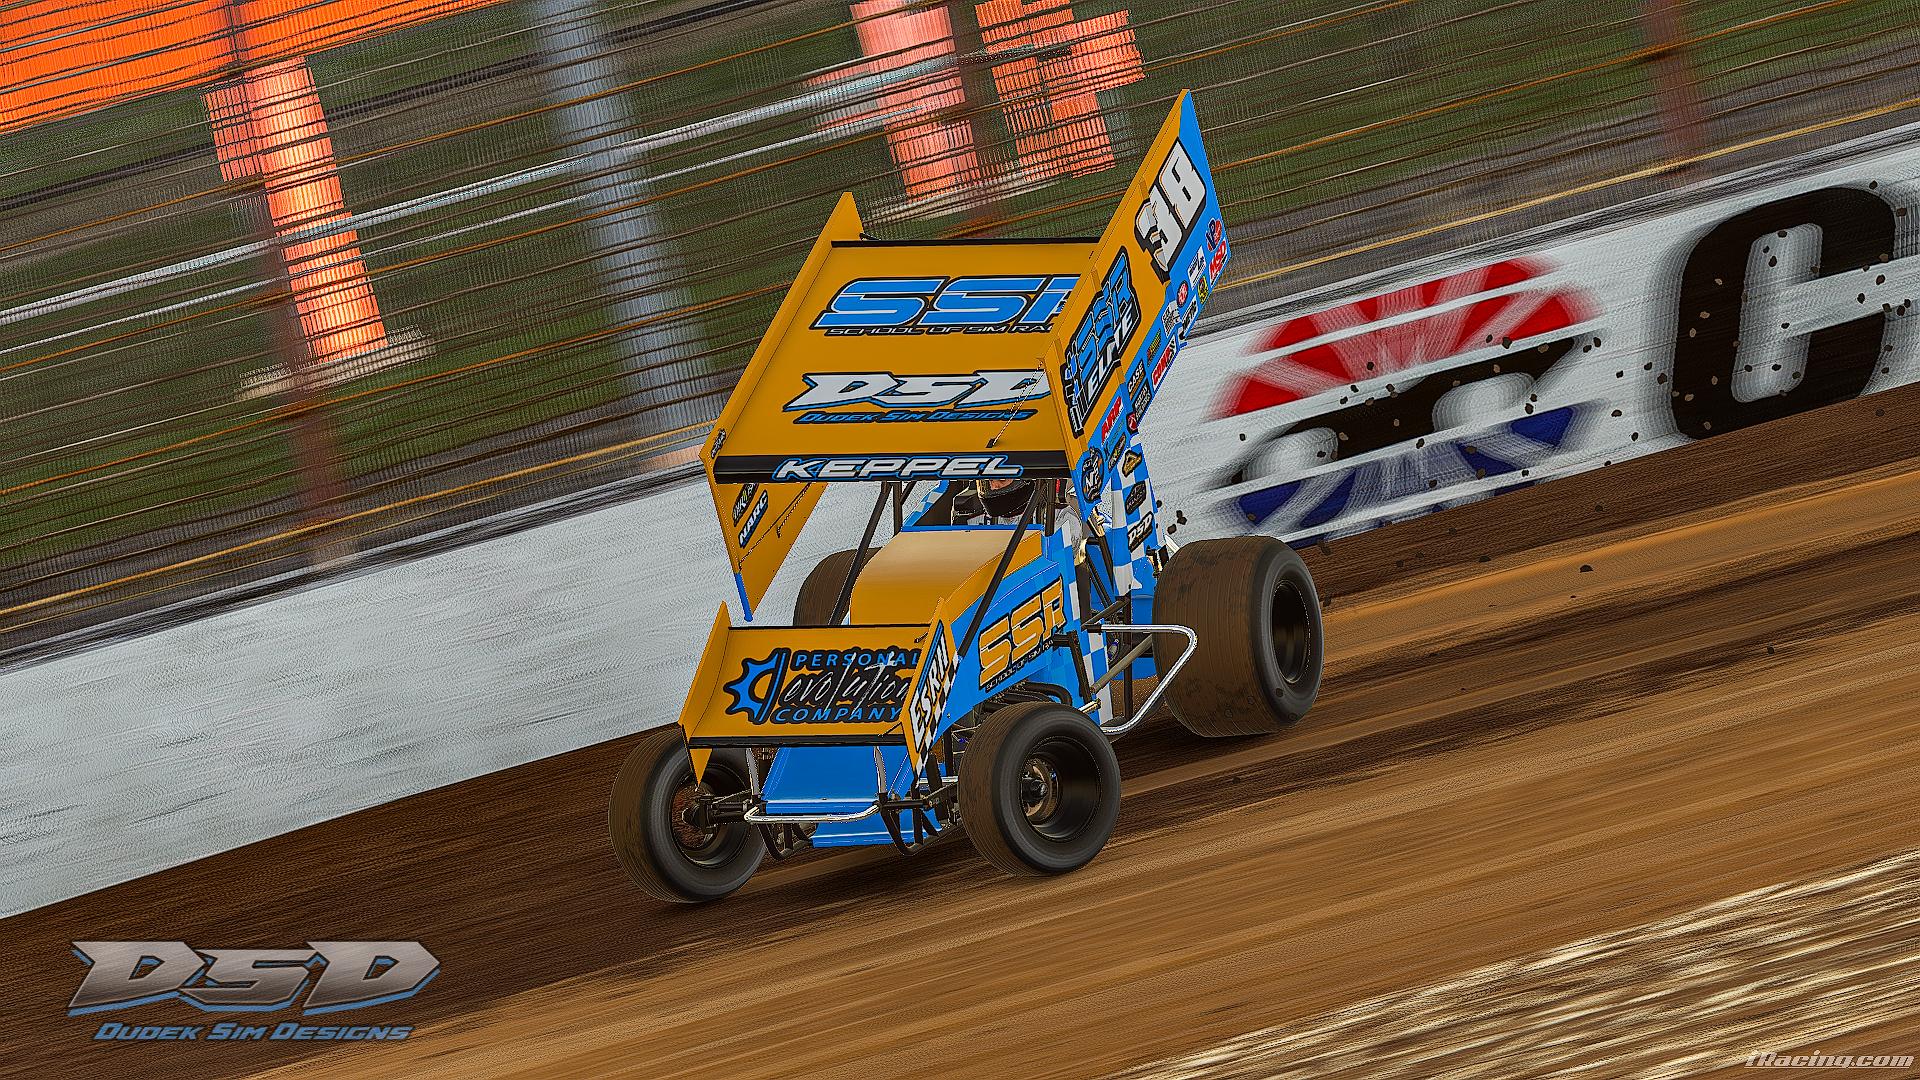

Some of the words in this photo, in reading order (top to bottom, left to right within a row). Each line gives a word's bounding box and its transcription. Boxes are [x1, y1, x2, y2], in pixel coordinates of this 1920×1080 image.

[827, 327, 922, 335] SCHOOL
[783, 371, 1050, 411] DSD
[880, 411, 925, 422] SIM
[776, 457, 1019, 479] KEPPEL
[980, 577, 1066, 687] SSR
[796, 653, 919, 667] PERSONAL
[776, 707, 902, 722] COMPANY
